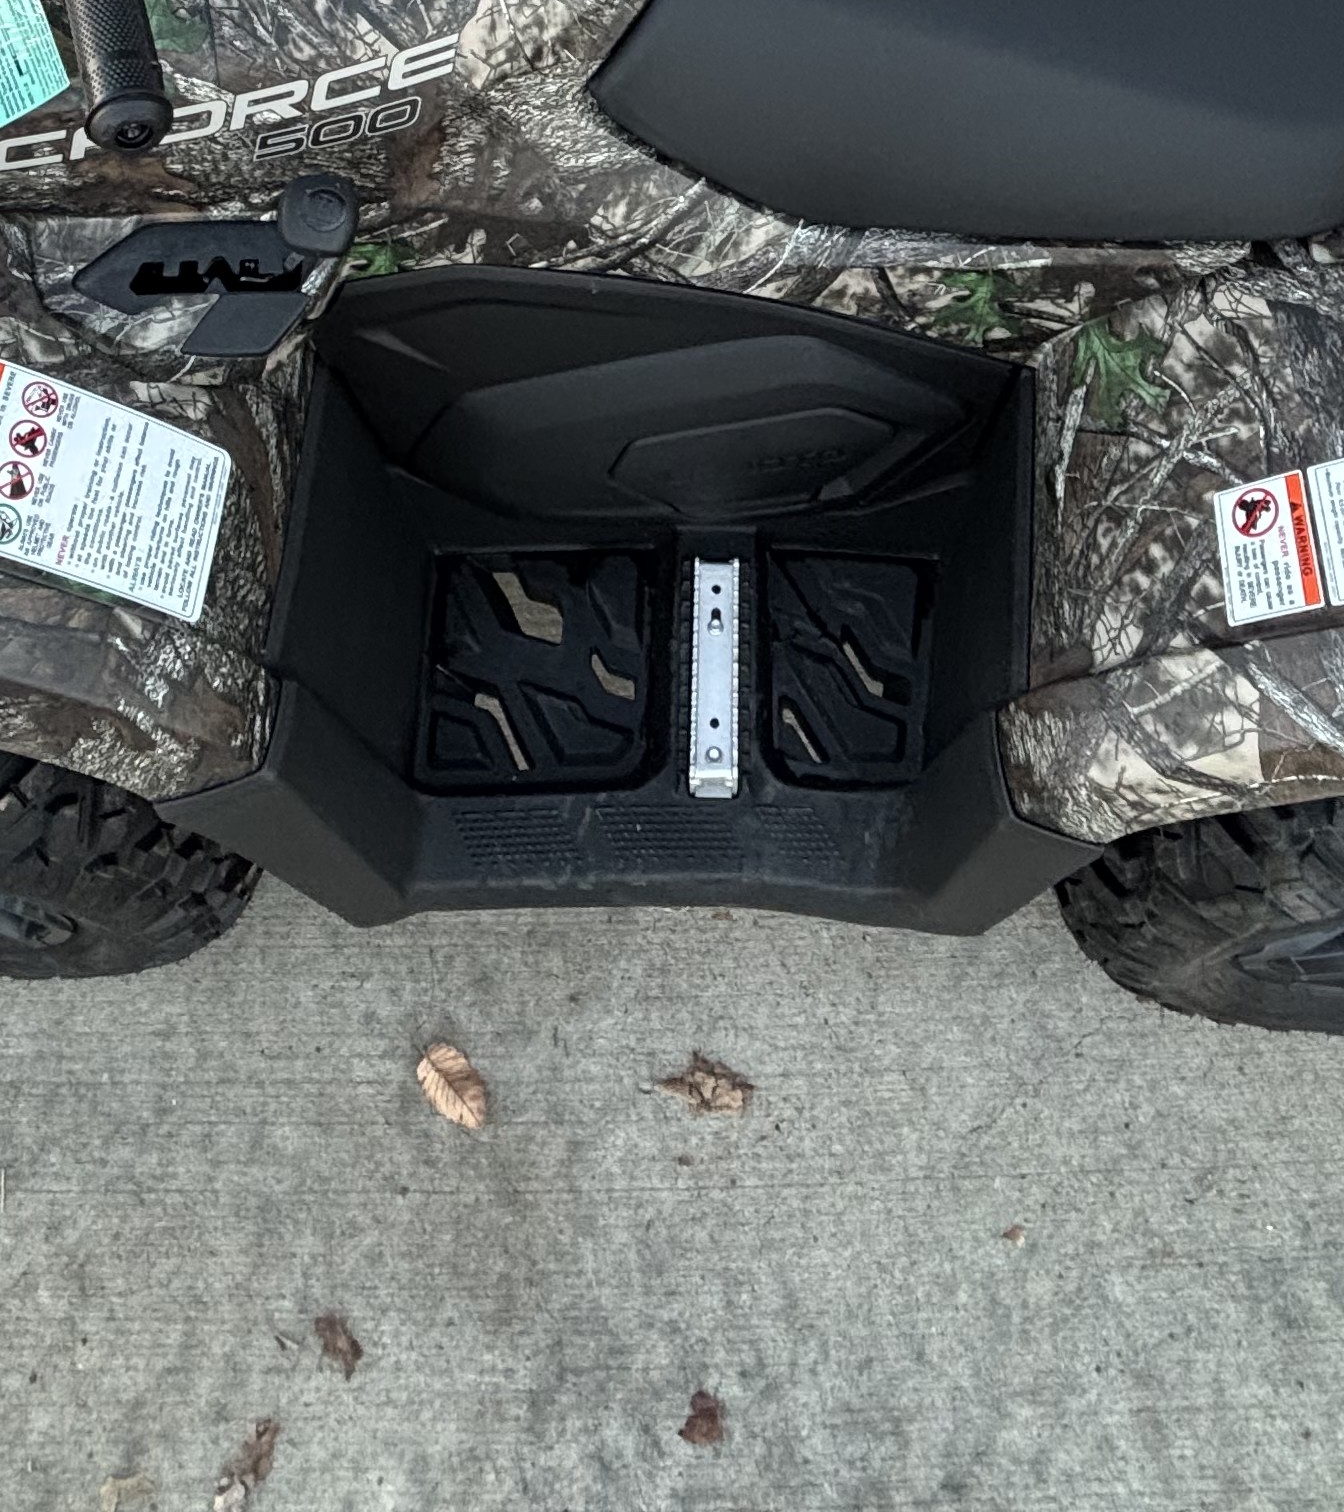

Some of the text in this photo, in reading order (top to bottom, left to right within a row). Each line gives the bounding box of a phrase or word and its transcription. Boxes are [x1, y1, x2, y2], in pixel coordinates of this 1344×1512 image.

[254, 96, 421, 162] 500
[1, 370, 16, 401] SEVERE
[55, 534, 69, 565] NEVER
[1277, 524, 1288, 557] NEVER
[1292, 514, 1313, 577] WARNING
[128, 555, 142, 593] ALWAYS
[1271, 559, 1285, 606] passenger
[1282, 560, 1292, 580] ride
[1286, 583, 1293, 595] as
